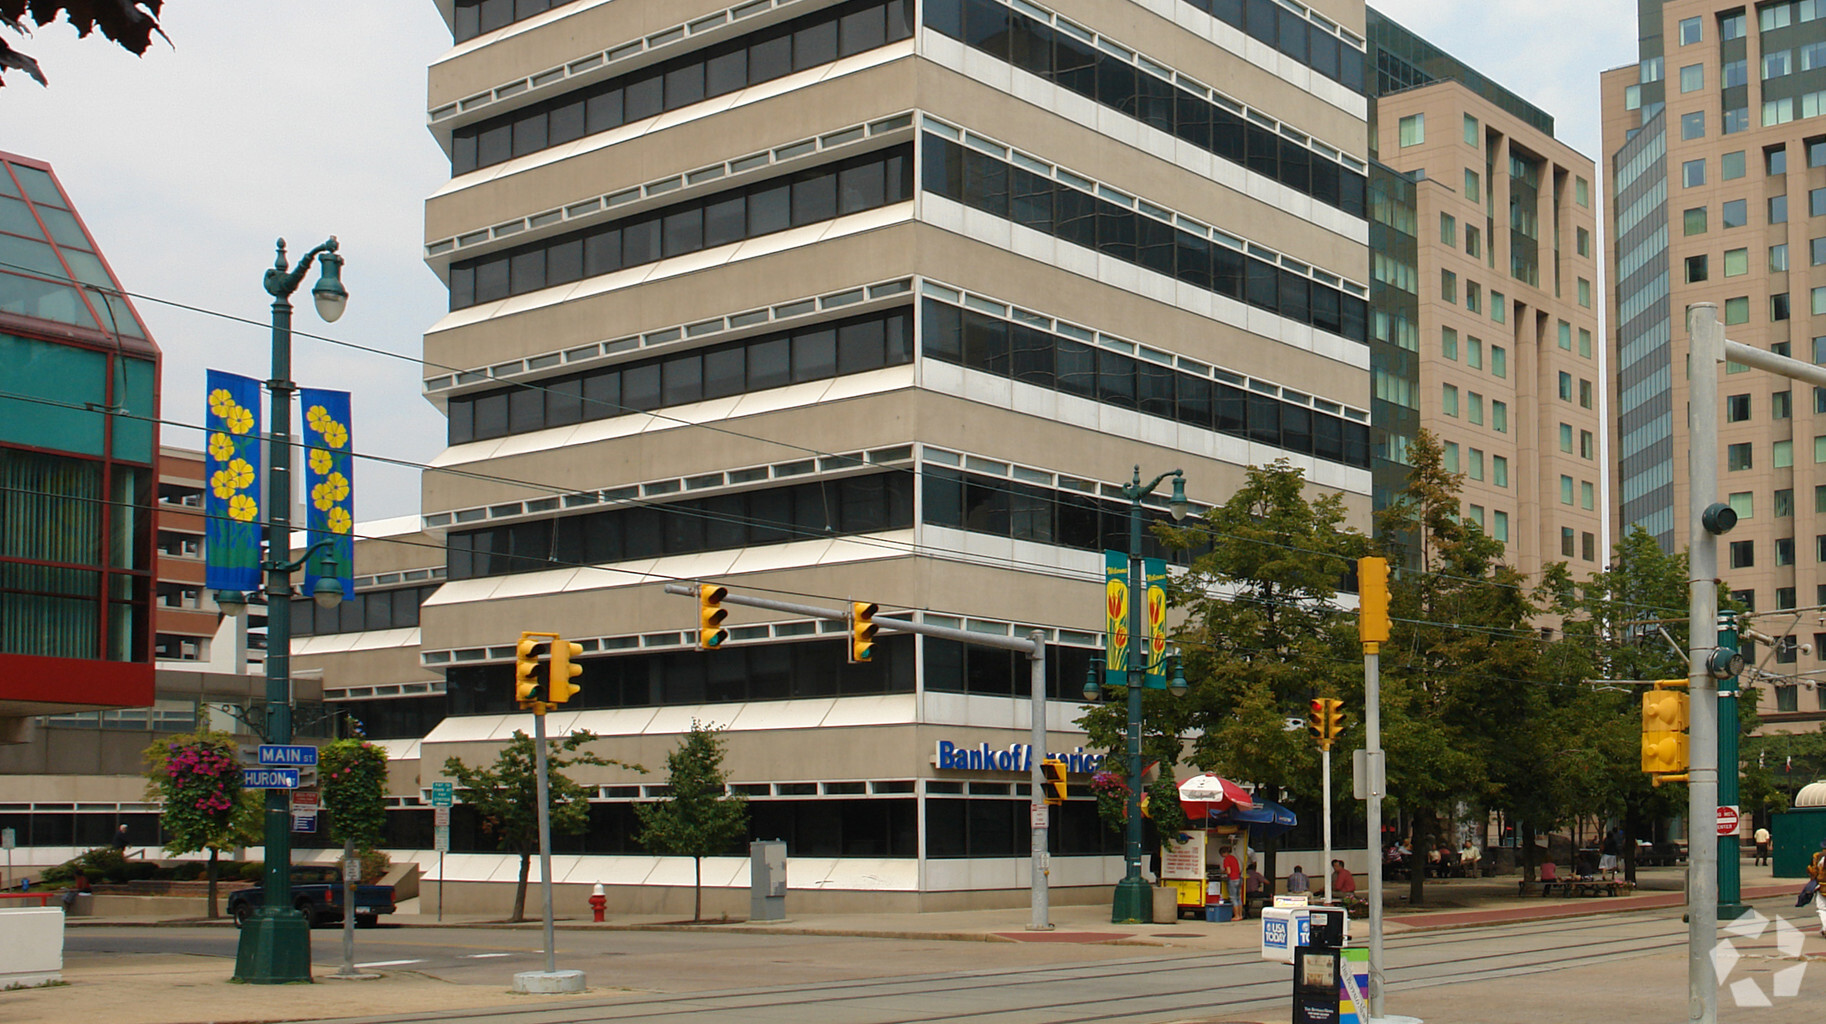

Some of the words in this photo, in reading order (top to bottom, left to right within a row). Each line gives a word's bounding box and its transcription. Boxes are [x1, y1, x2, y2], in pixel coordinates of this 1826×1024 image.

[262, 748, 301, 763] MAIN
[936, 740, 997, 771] Bank
[997, 743, 1021, 772] of
[244, 771, 286, 786] HURON
[1272, 922, 1286, 934] USA
[1265, 932, 1287, 944] TODAY
